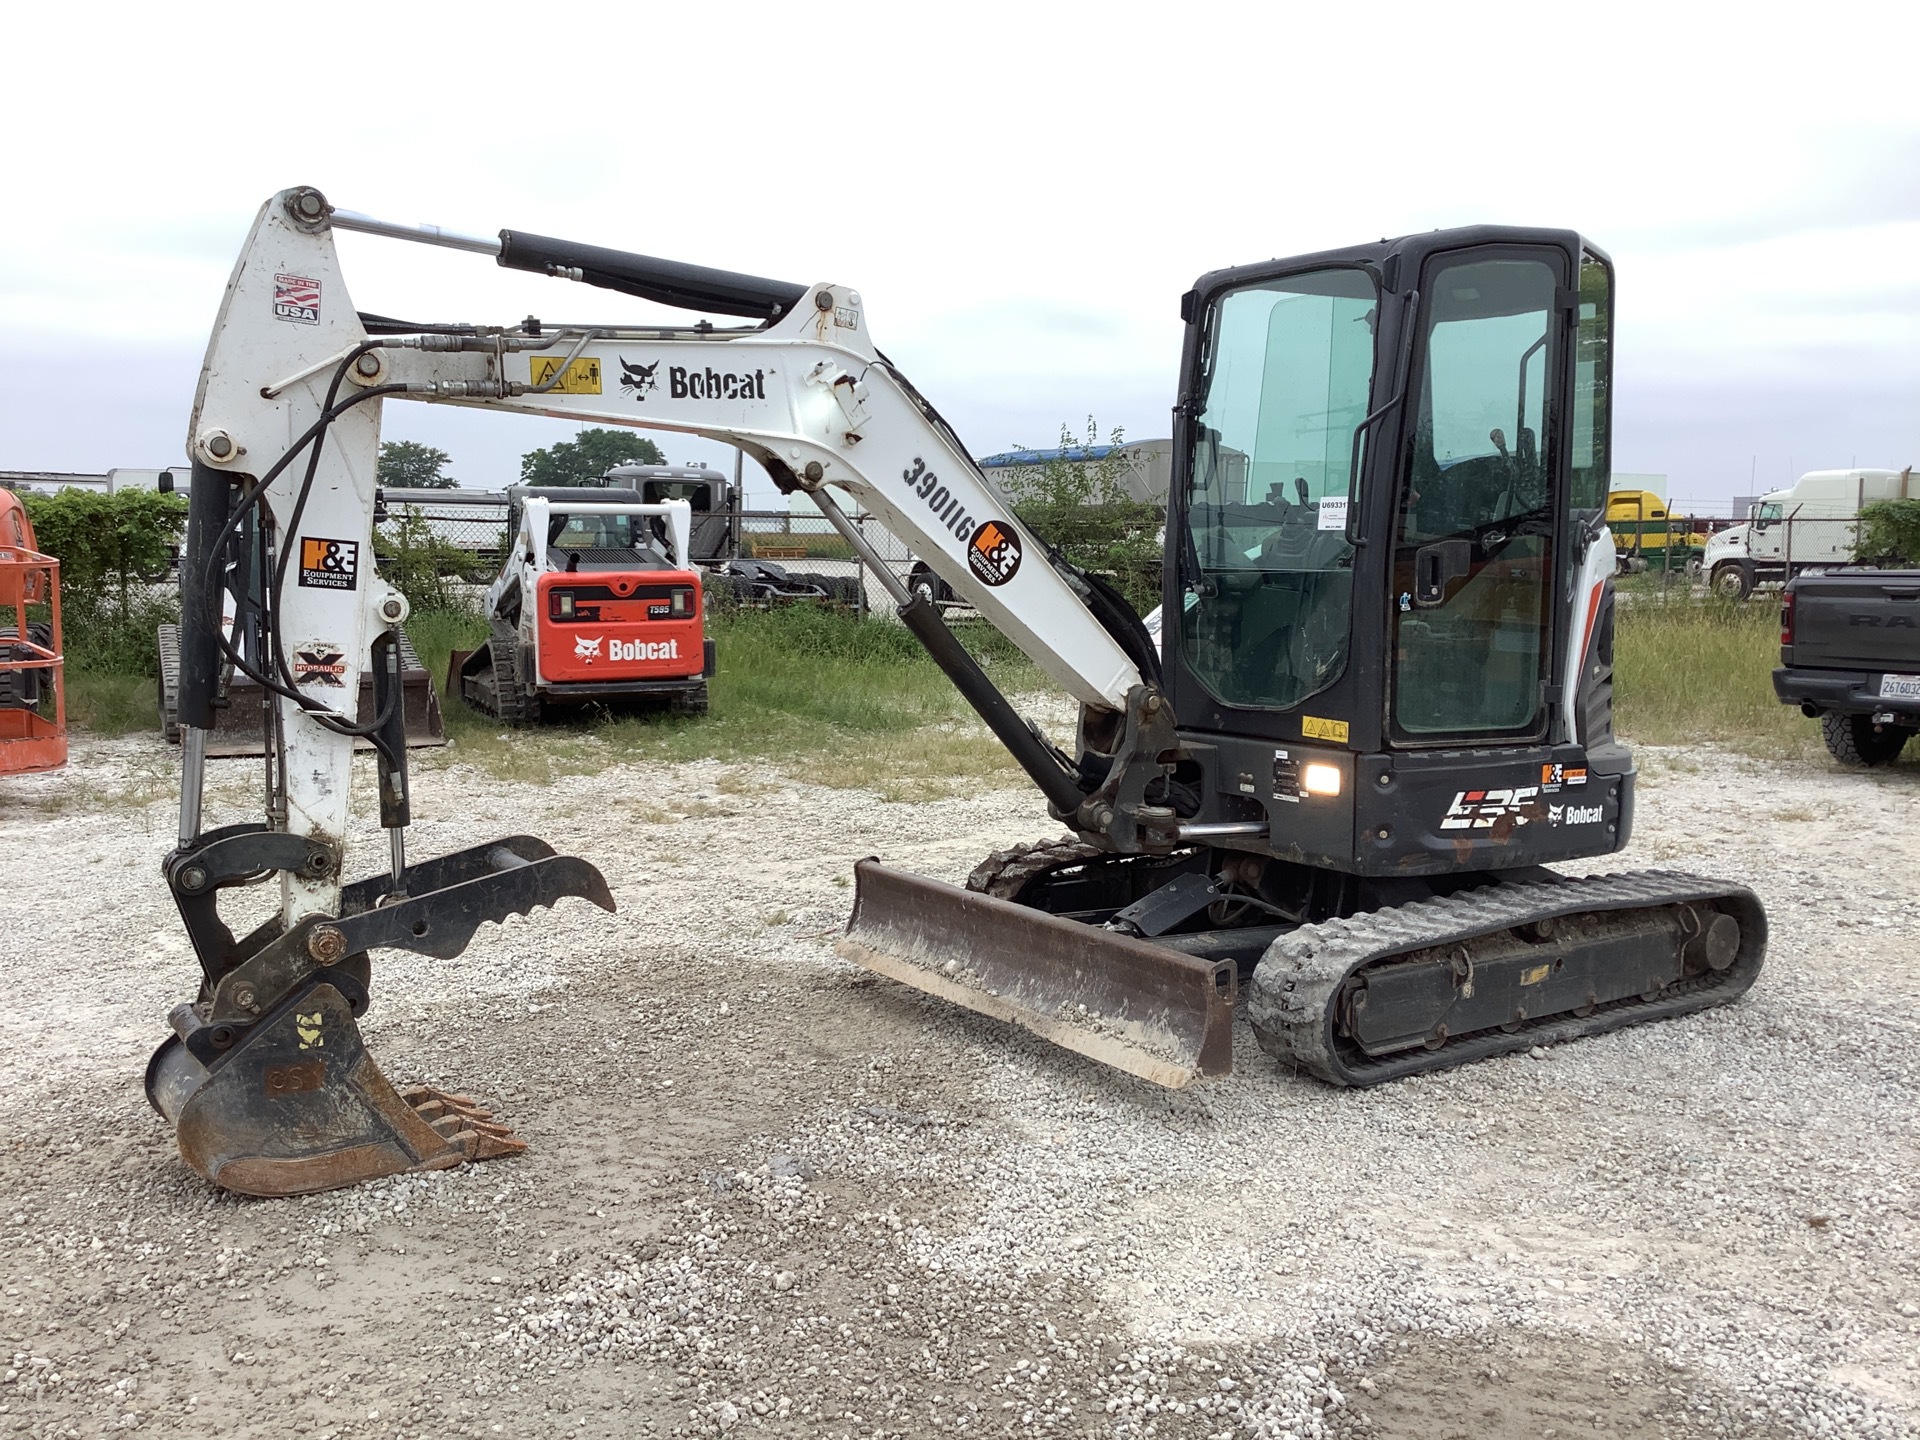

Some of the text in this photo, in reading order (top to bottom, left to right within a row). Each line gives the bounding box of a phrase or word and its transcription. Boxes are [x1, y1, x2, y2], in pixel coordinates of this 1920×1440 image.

[276, 304, 316, 320] USA
[669, 366, 766, 400] Bobcat
[903, 457, 976, 542] 390116
[1321, 501, 1348, 509] U69331
[303, 540, 356, 573] H&E
[975, 522, 1020, 577] H&E
[969, 554, 997, 585] SERVICES
[970, 545, 1004, 582] EQUIPMENT
[303, 569, 354, 580] EQUIPMENT
[306, 577, 348, 587] SERVICES
[650, 605, 670, 614] T595
[609, 639, 678, 661] Bobcat
[296, 664, 344, 673] HYDRAULIC
[1542, 763, 1563, 784] H&E
[1565, 804, 1603, 825] Bobcat
